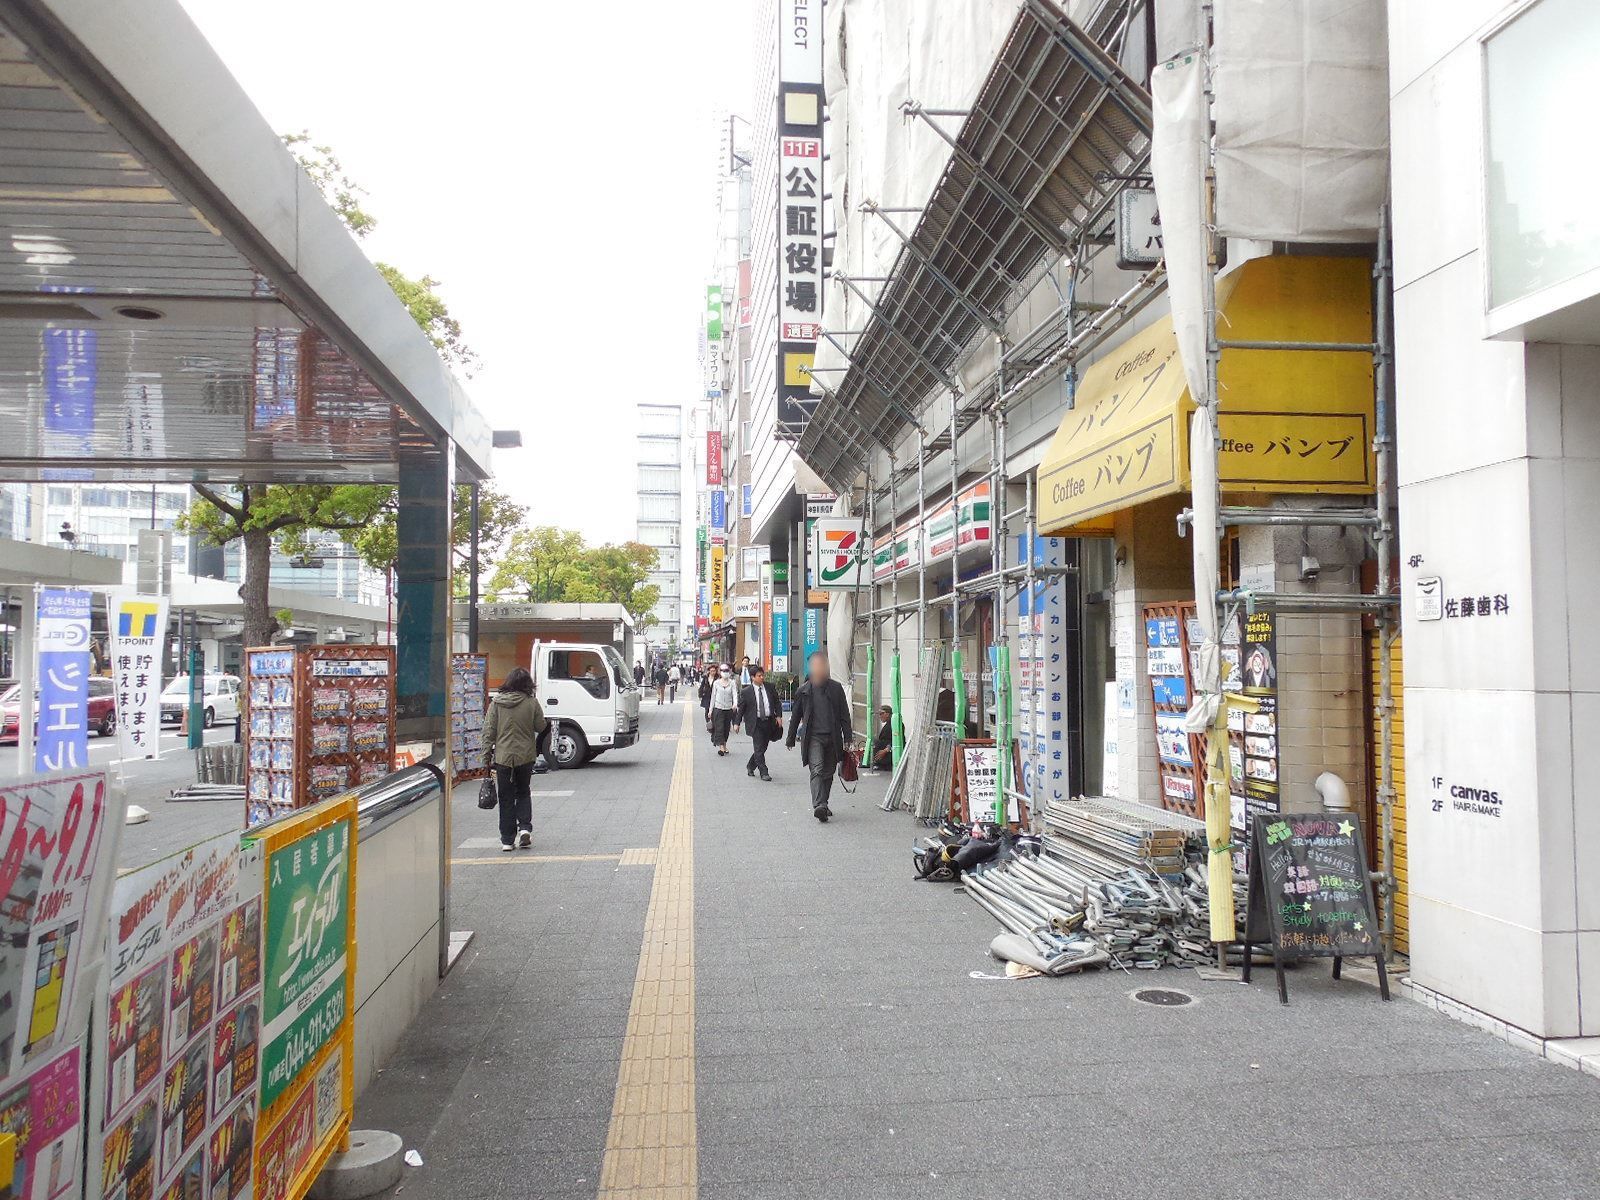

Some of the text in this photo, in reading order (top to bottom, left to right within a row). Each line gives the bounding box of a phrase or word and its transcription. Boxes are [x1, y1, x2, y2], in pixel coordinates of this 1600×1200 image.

[787, 142, 816, 156] 11F
[785, 166, 818, 313] 公証役場
[1114, 348, 1156, 381] Coffee
[1093, 433, 1157, 492] バンブ
[1262, 435, 1355, 461] バンブ
[1052, 471, 1085, 505] Coffee
[1445, 594, 1509, 619] 佐藤歯科
[118, 638, 155, 646] T-POINT
[117, 654, 131, 730] 使えます。
[131, 654, 153, 748] 貯まります。
[1432, 776, 1443, 789] 1F
[1450, 785, 1503, 805] canvas.
[1432, 799, 1443, 812] 2F
[1453, 800, 1501, 818] HAIR&MAKE
[271, 826, 349, 888] 入居者募集
[279, 851, 343, 988] エイブル
[1283, 912, 1313, 927] Study
[110, 921, 163, 981] エイブル
